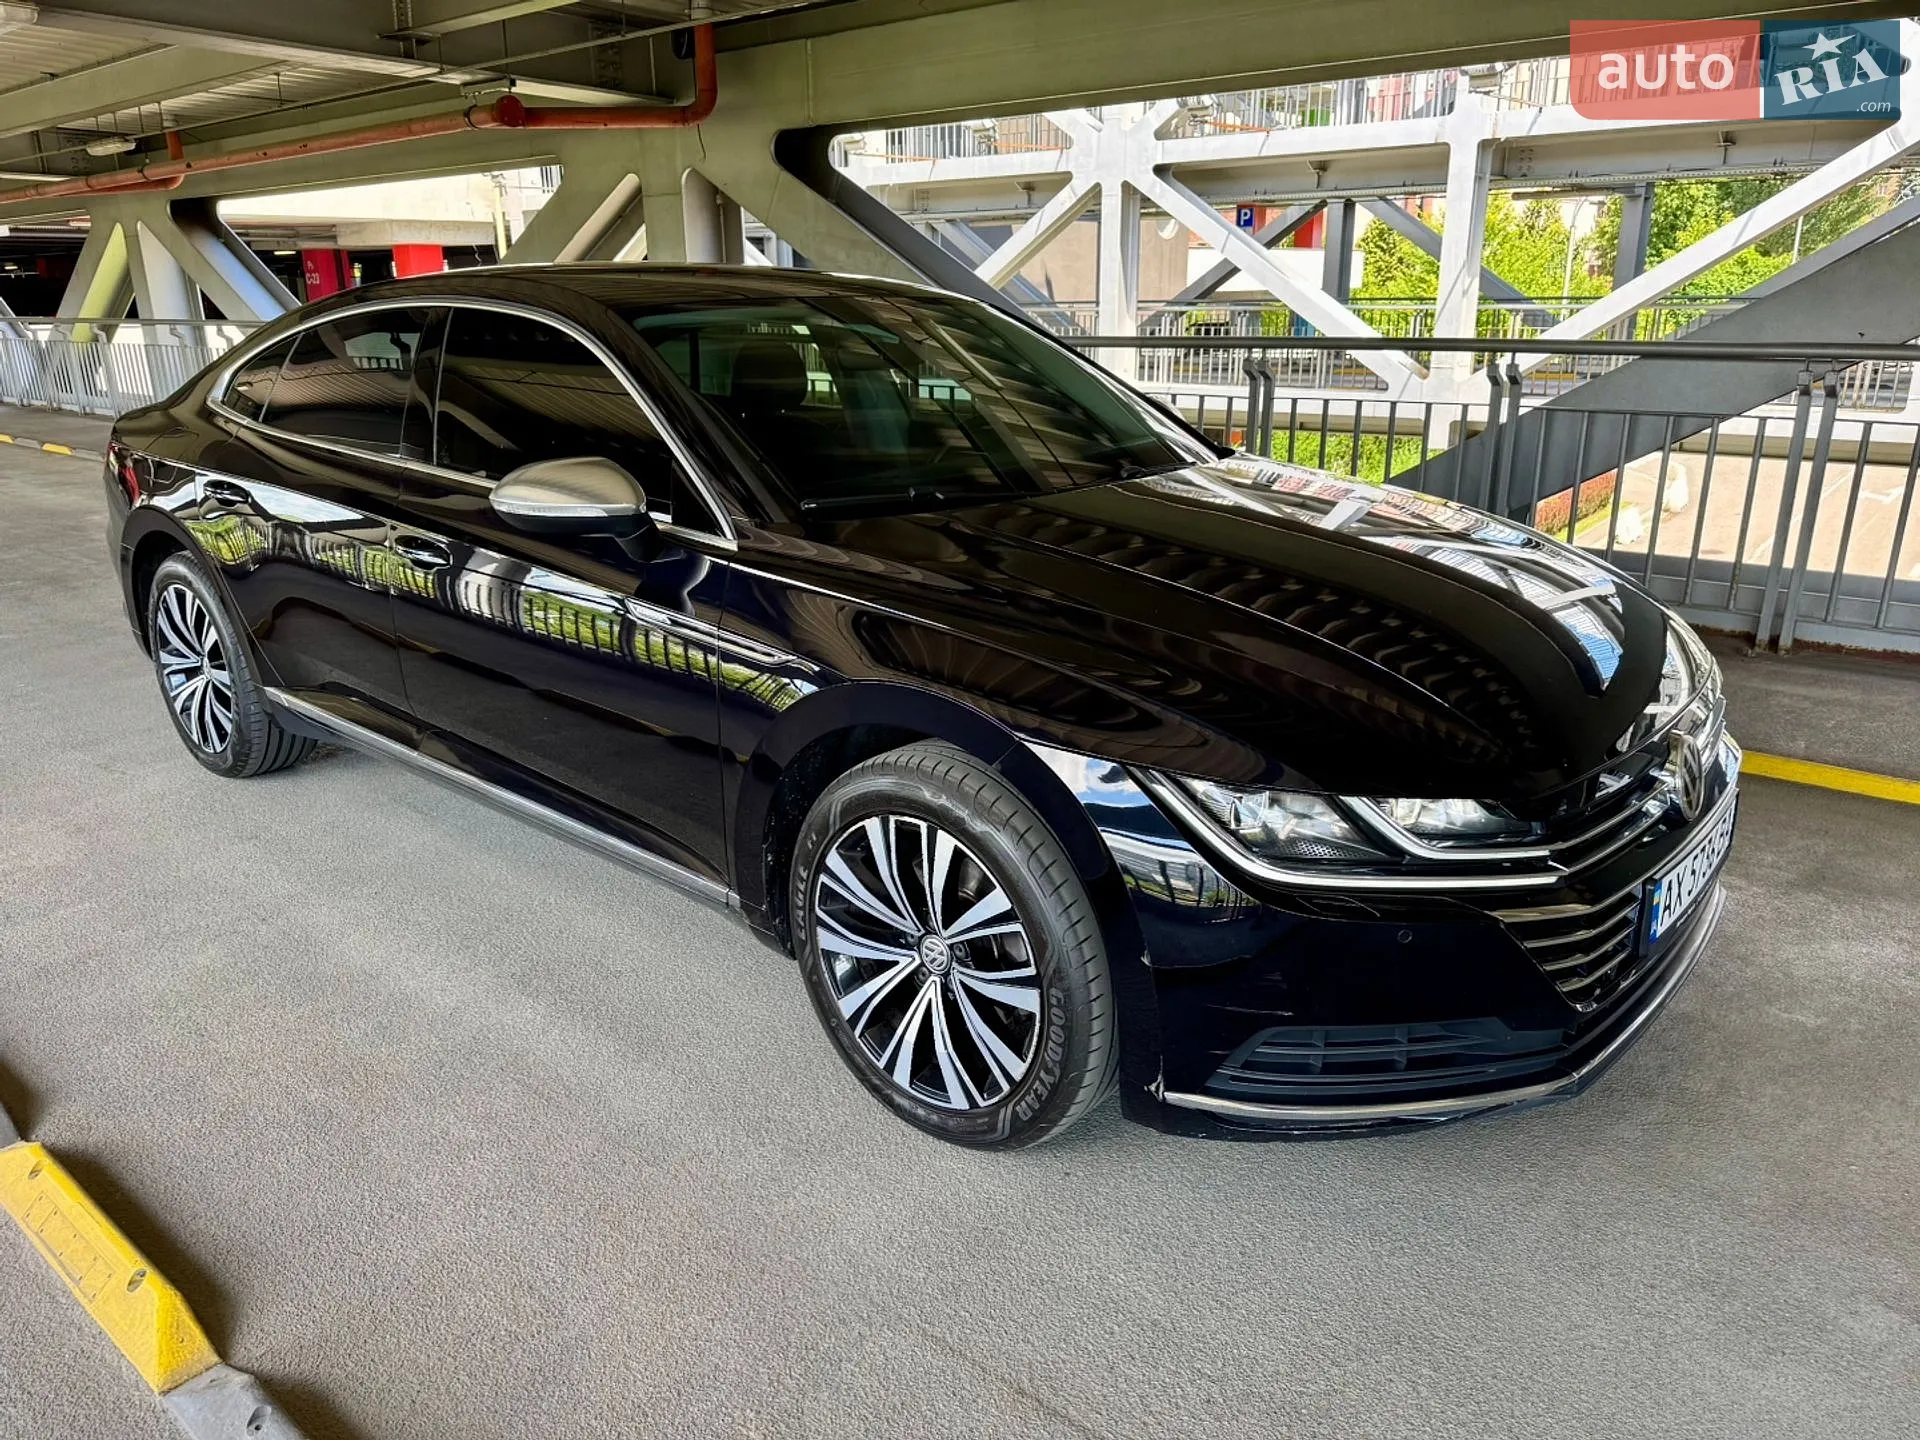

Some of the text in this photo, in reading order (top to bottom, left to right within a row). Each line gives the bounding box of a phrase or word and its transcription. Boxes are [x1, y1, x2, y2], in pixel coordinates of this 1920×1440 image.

[1240, 209, 1251, 226] P
[1660, 865, 1688, 927] AX
[1015, 987, 1066, 1122] GOODYEAR
